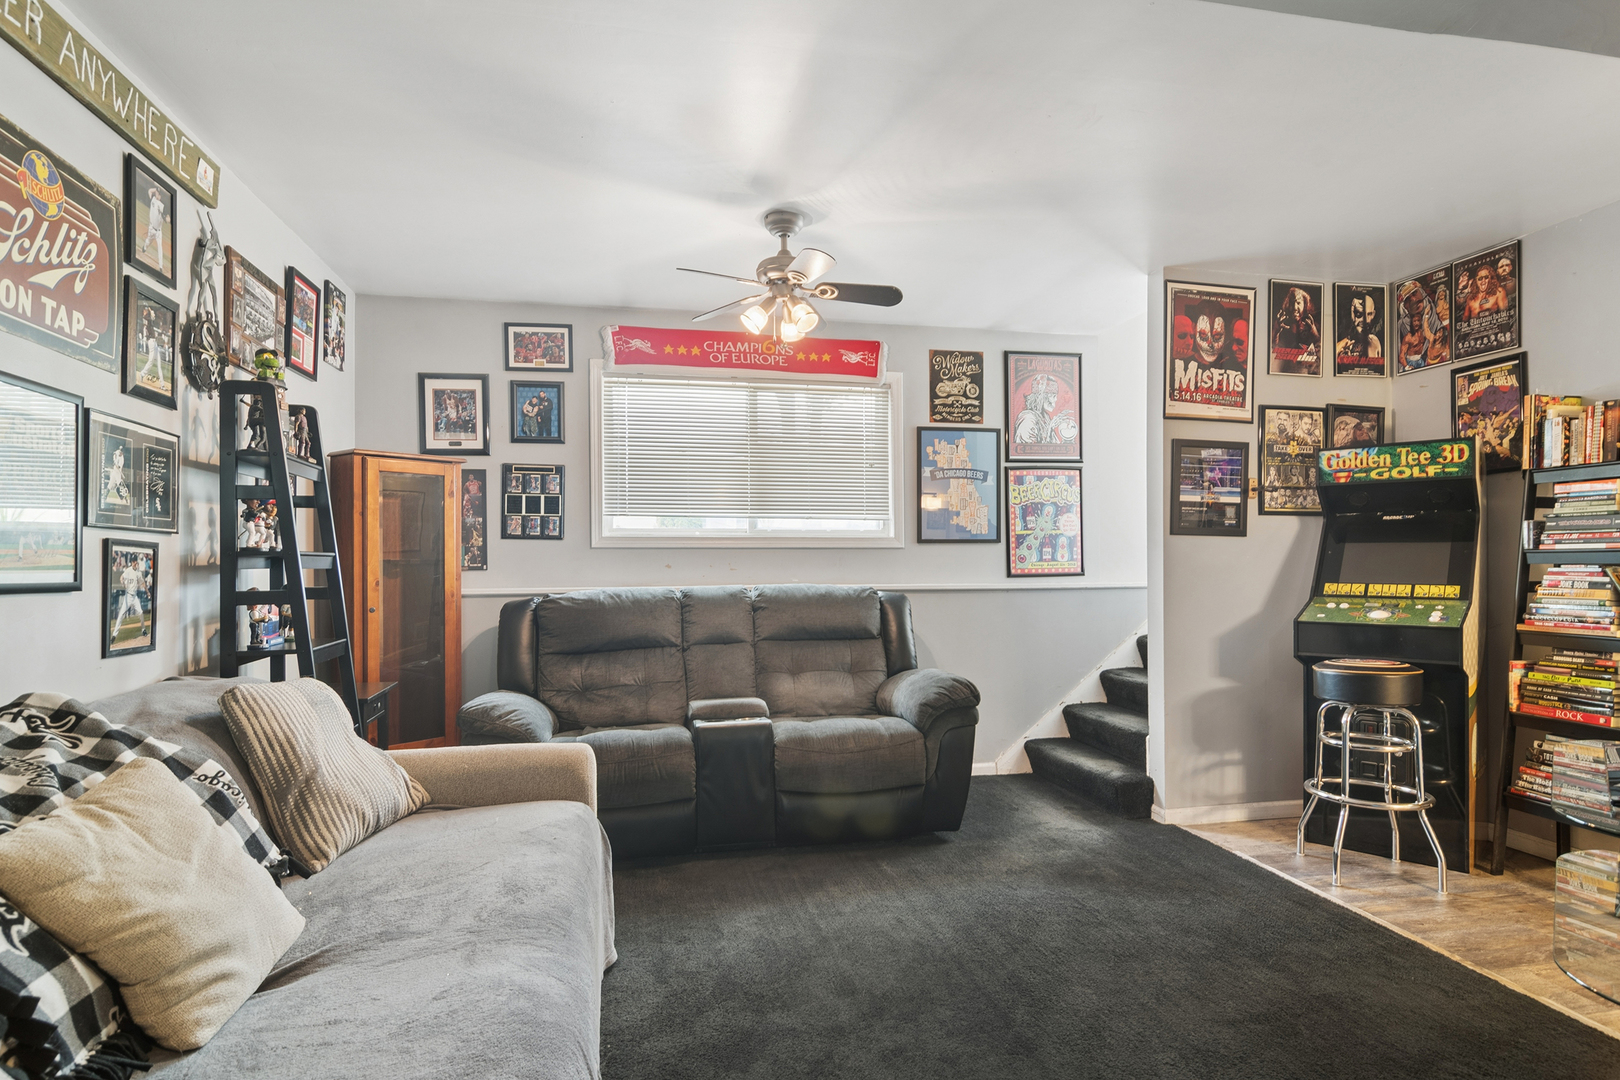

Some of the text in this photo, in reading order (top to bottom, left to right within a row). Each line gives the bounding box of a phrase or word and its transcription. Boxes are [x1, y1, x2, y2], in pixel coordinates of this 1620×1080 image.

[0, 0, 194, 179] ER ANYWHERE
[32, 181, 62, 202] SCHLITZ
[0, 206, 97, 294] Schlitz
[1, 279, 85, 337] ON TAP
[710, 353, 789, 366] OF EUROPE
[1174, 358, 1245, 392] MISFITS
[1173, 390, 1201, 401] 5.14.16
[1467, 374, 1519, 398] SPRING BREAK
[1323, 443, 1469, 470] Golden Tee 3D
[944, 469, 967, 478] CHICAGO
[967, 471, 985, 480] BEERS
[1573, 581, 1589, 589] BOOK
[1556, 710, 1584, 721] ROCK
[1522, 774, 1535, 783] The
